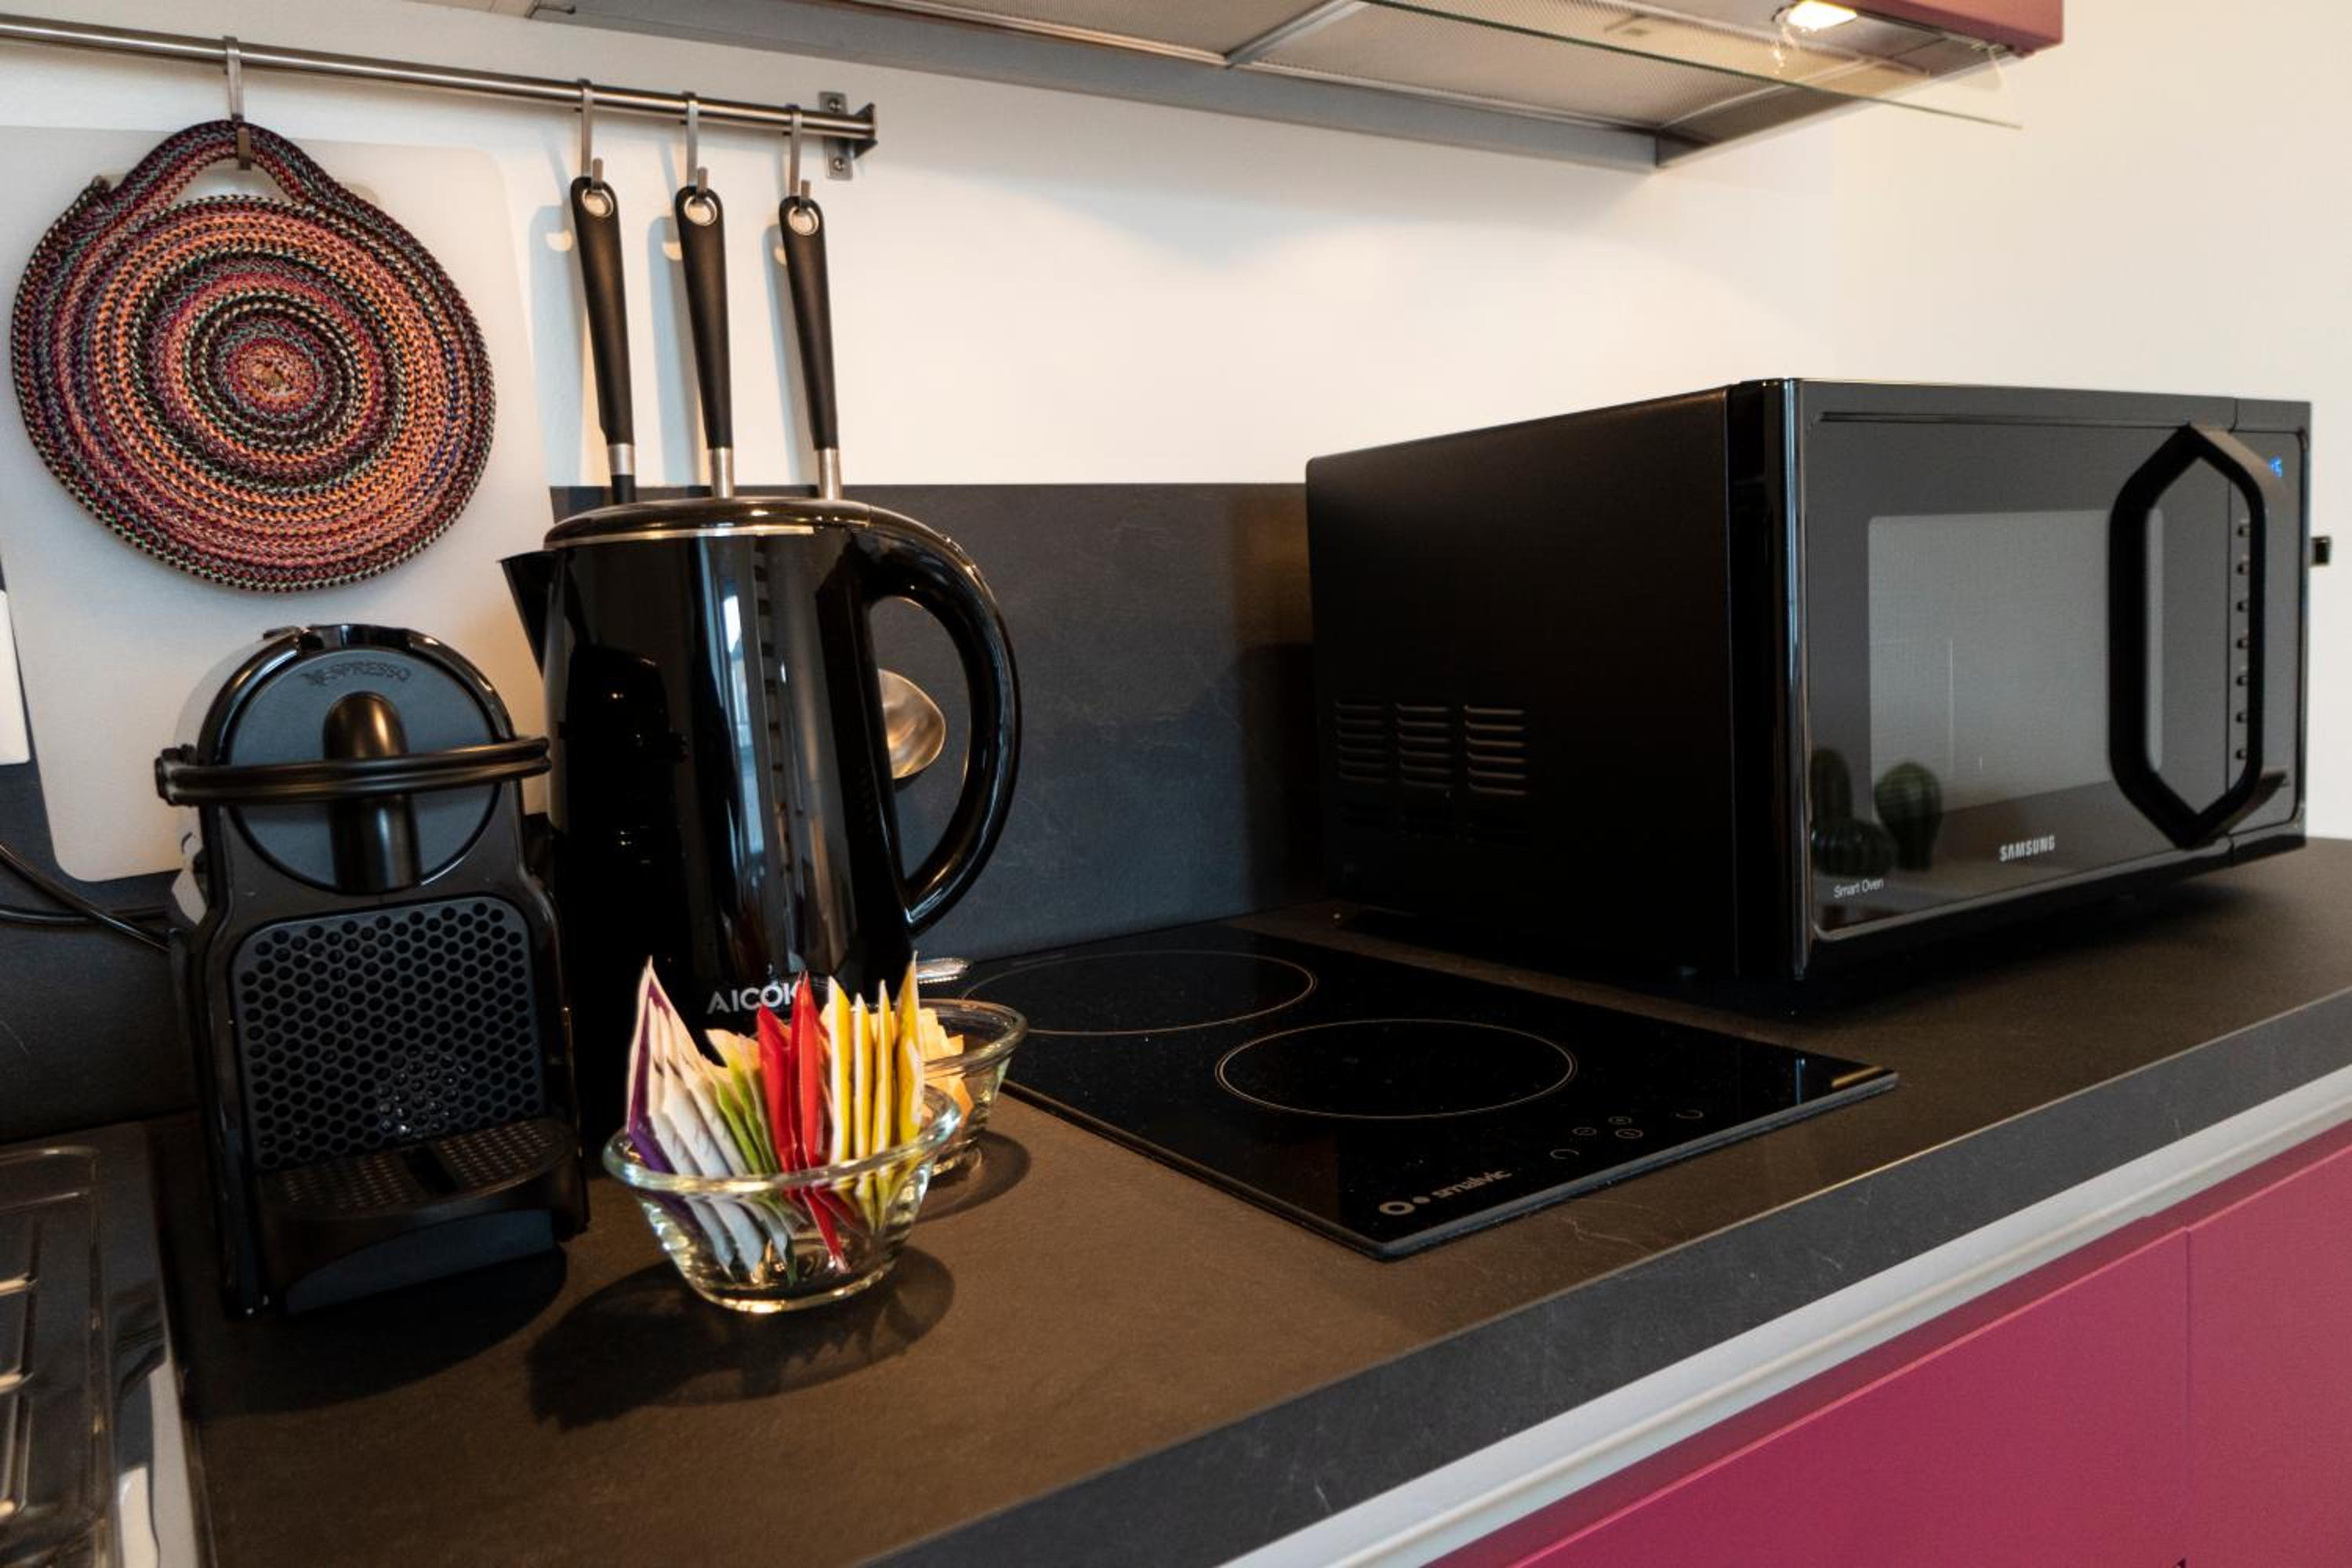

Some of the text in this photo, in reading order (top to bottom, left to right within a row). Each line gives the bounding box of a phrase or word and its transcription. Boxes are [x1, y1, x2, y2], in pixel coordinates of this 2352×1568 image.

[1999, 834, 2056, 862] SAMSUNG
[1833, 877, 1885, 898] Smart Oven
